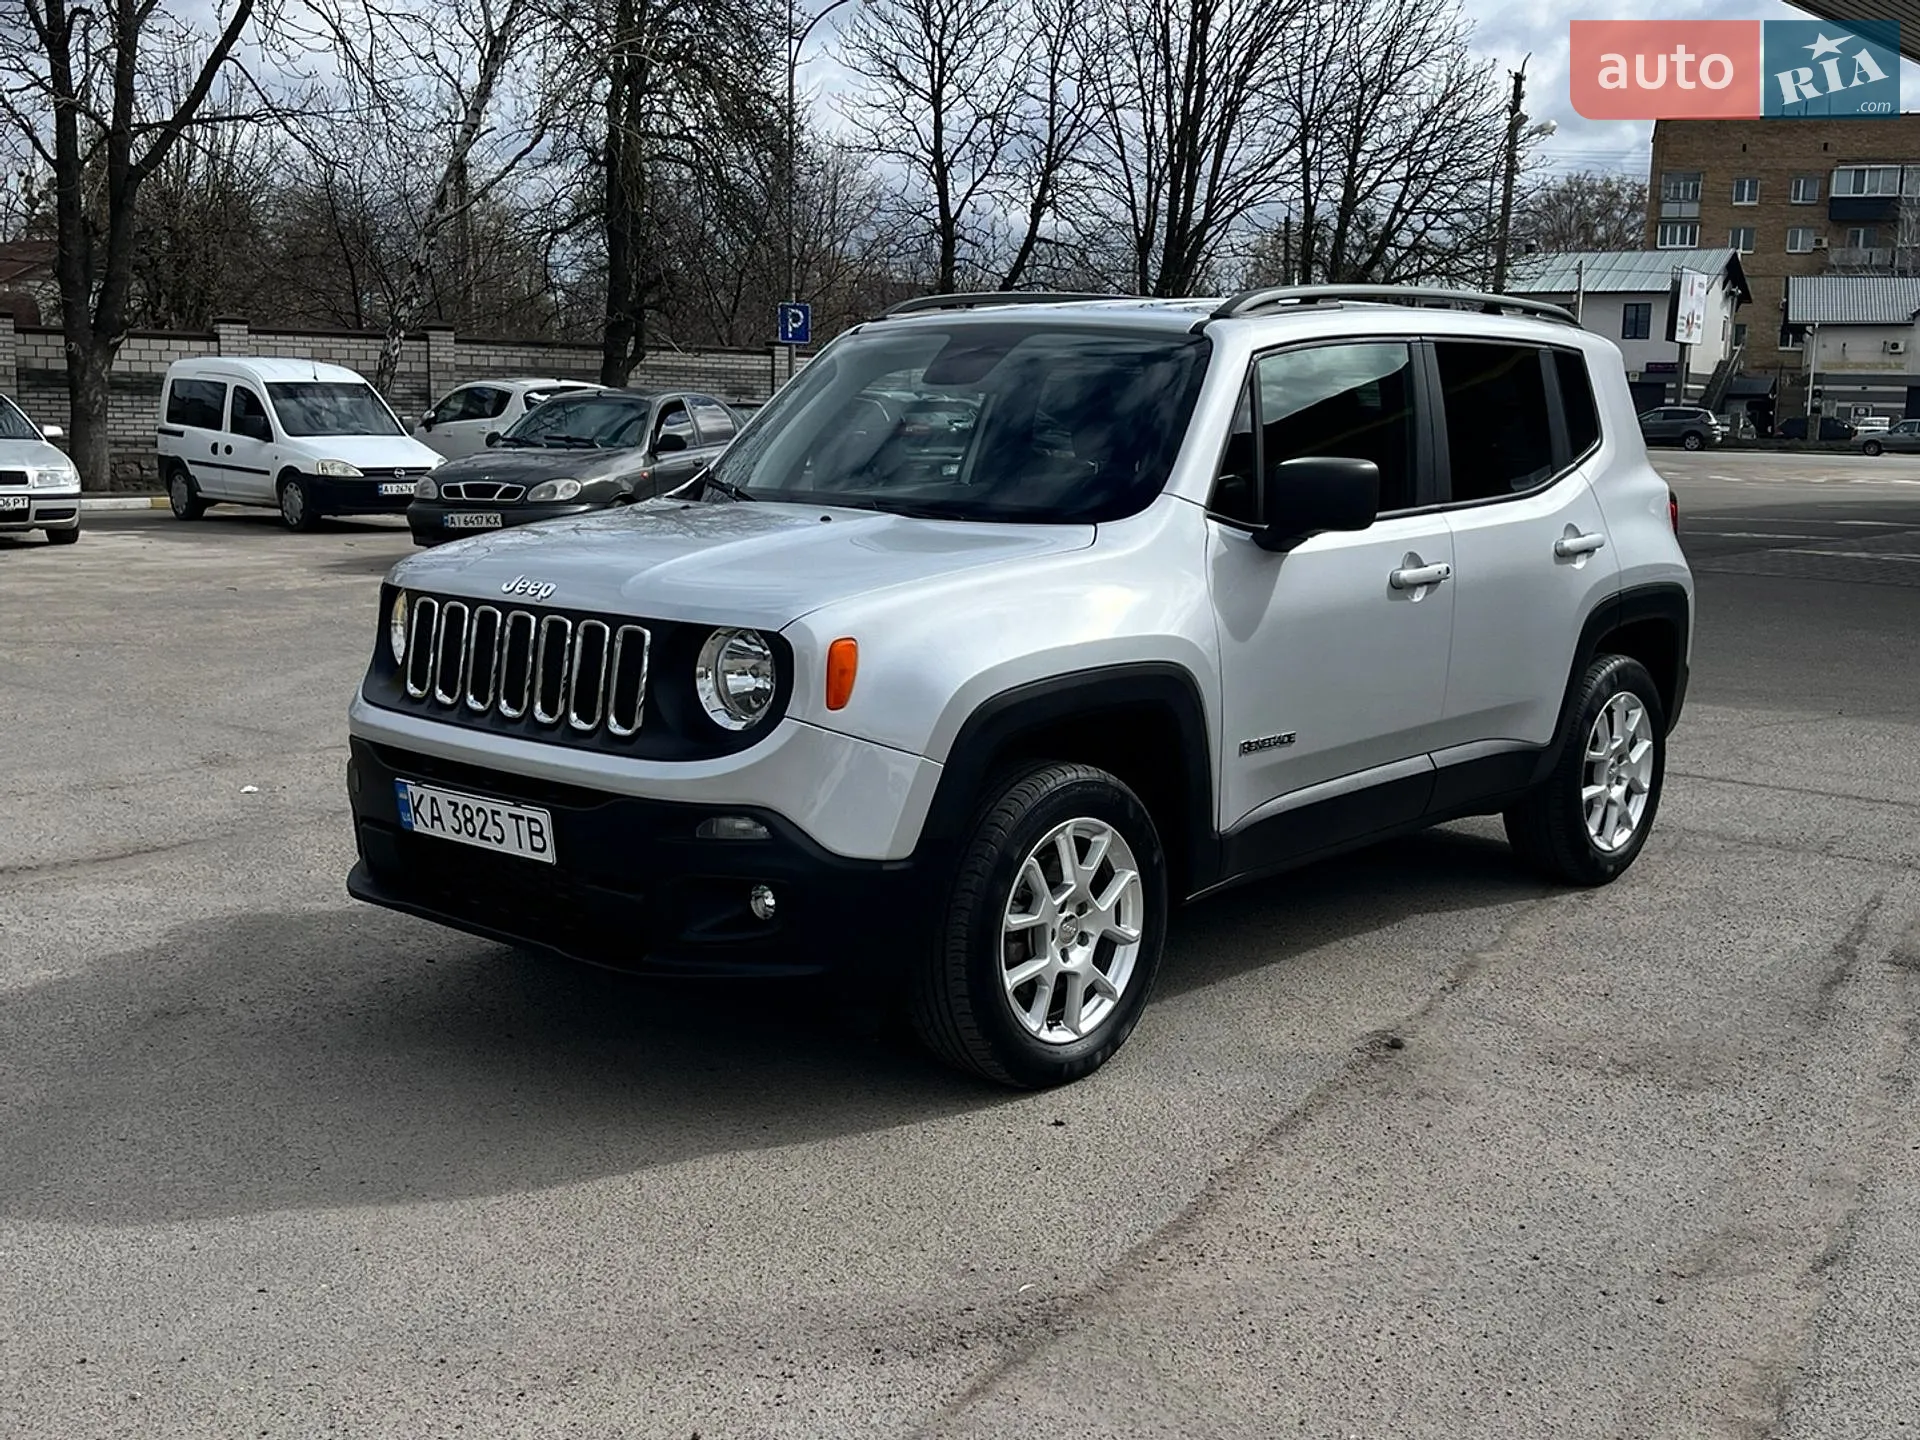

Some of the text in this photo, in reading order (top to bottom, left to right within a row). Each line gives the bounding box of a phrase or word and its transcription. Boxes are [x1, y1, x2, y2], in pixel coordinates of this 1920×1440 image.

[788, 307, 804, 338] P
[501, 575, 557, 602] Jeep
[1239, 731, 1296, 757] RENEGADE
[409, 791, 546, 853] KA 3825 TB
